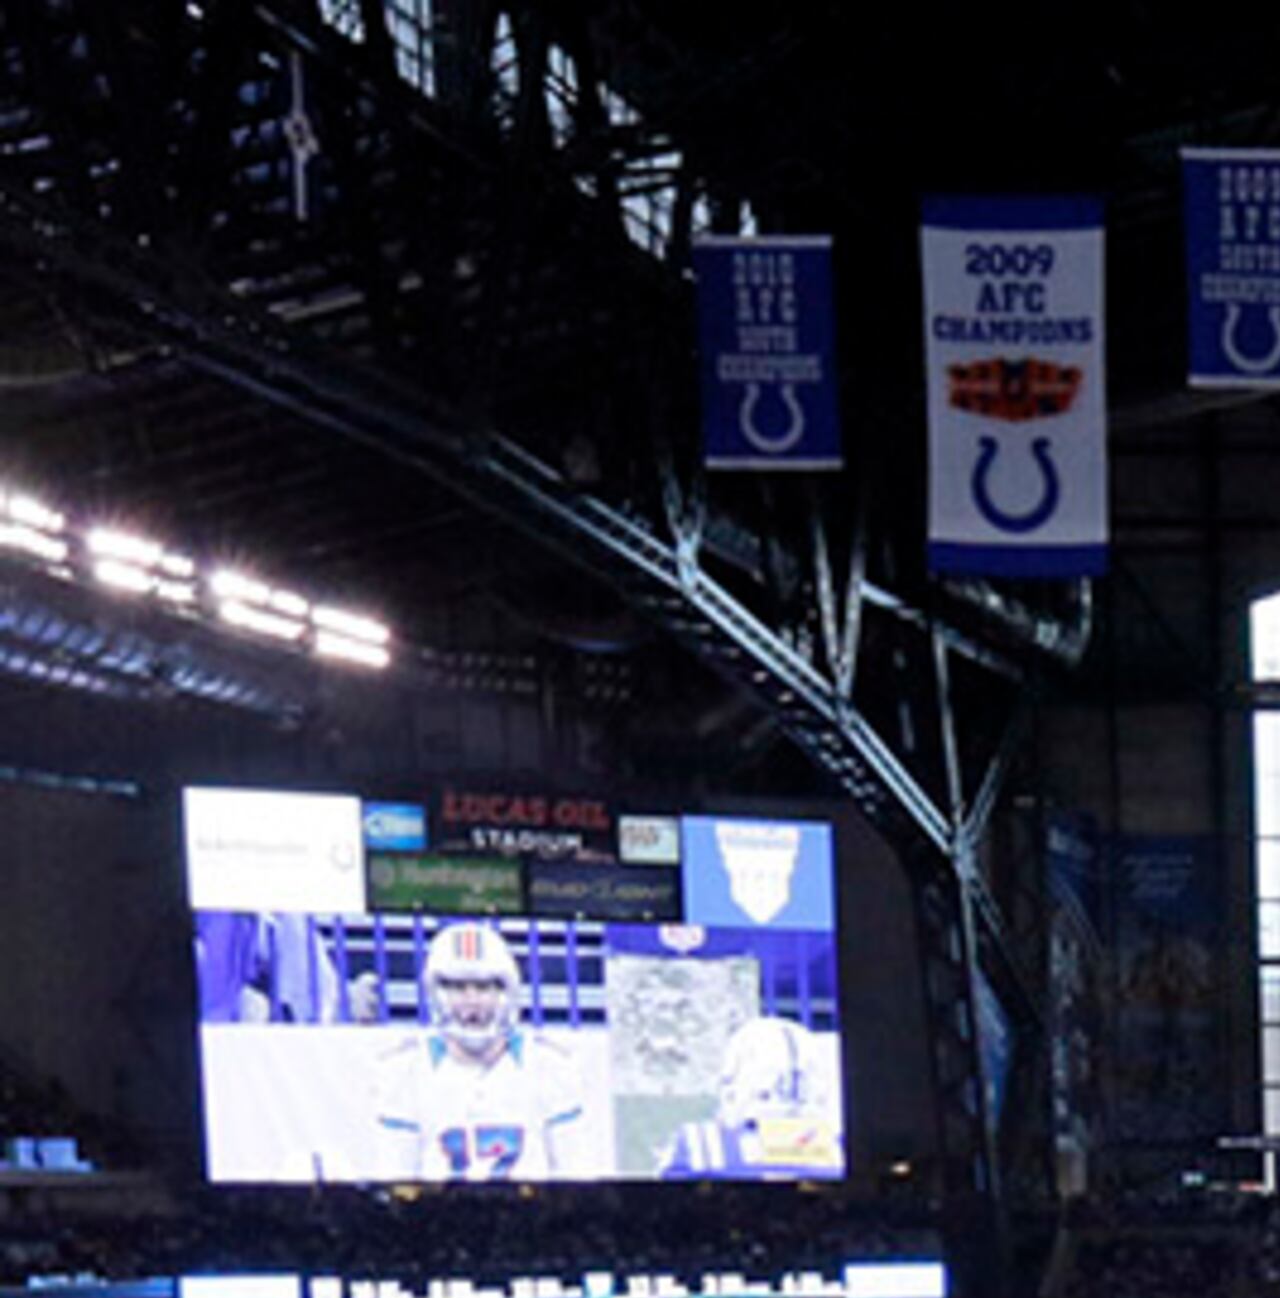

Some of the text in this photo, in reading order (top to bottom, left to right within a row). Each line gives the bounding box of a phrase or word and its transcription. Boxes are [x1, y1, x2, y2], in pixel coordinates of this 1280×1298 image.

[965, 244, 1054, 276] 2009
[977, 284, 1045, 313] AFC
[933, 316, 1092, 343] CHAMPIONS
[442, 792, 546, 826] LUCAS
[553, 798, 610, 830] OIL
[471, 827, 585, 852] STADIUM
